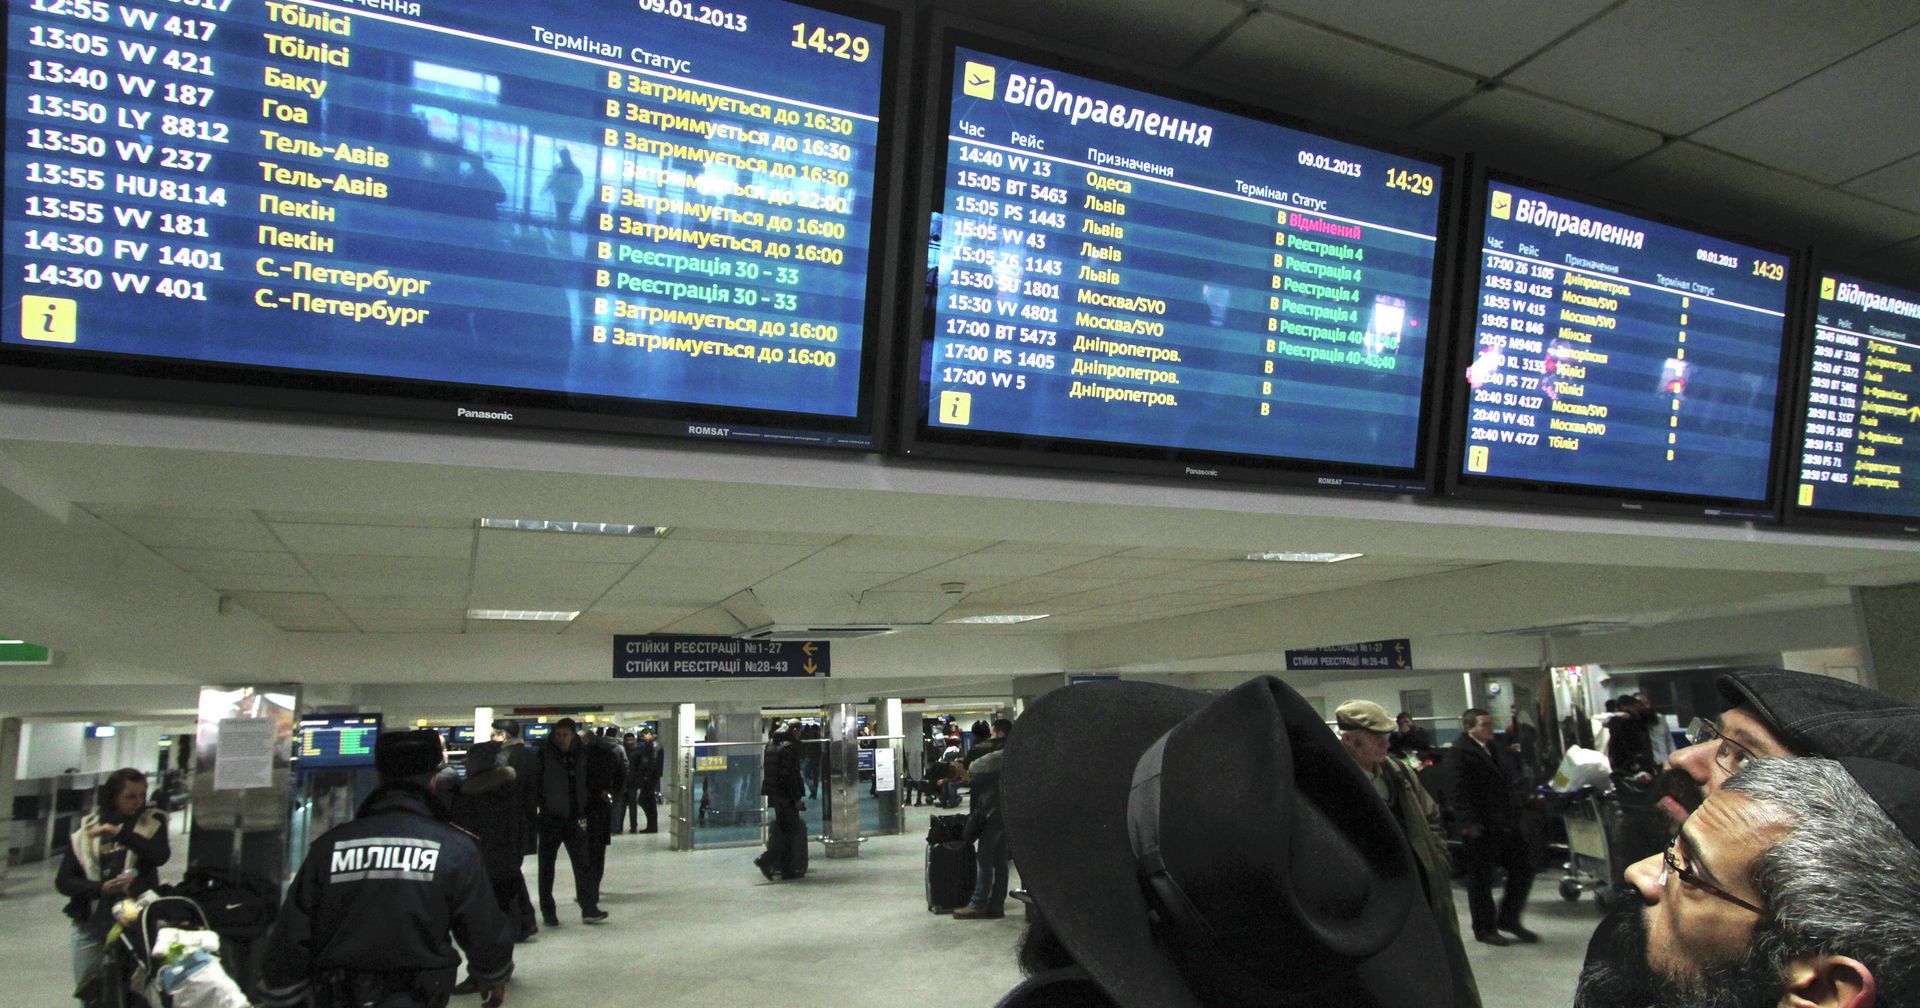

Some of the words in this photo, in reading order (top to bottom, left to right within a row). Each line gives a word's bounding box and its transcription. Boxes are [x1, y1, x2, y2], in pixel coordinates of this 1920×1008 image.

[119, 6, 159, 31] VV
[164, 16, 217, 41] 417
[265, 1, 351, 36] Тбілісі
[639, 0, 747, 32] 09.01.2013
[30, 26, 109, 56] 13:05
[118, 40, 157, 64] VV
[163, 50, 214, 76] 421
[264, 33, 349, 67] Тбілісі
[532, 26, 622, 60] Термінал
[631, 48, 691, 74] Статус
[791, 22, 869, 62] 14:29
[29, 60, 108, 90] 13:40
[117, 74, 156, 97] VV
[164, 83, 214, 107] 187
[264, 67, 328, 104] Баку
[263, 98, 308, 124] Гоа
[625, 72, 772, 123] Затримується
[773, 105, 801, 128] до
[803, 108, 853, 136] 16:30
[1004, 74, 1212, 147] Відправлення
[28, 94, 107, 124] 13:50
[118, 107, 152, 130] LY
[161, 115, 229, 143] 8812
[623, 101, 770, 150] Затримується
[771, 133, 799, 155] до
[801, 134, 851, 162] 16:30
[27, 128, 106, 157] 13:50
[115, 140, 154, 163] VV
[160, 147, 212, 172] 237
[260, 130, 389, 168] Тель-Авів
[622, 129, 768, 177] Затримується
[769, 160, 797, 182] до
[799, 161, 849, 188] 16:30
[960, 146, 1003, 167] 14:40
[1008, 155, 1029, 172] VV
[1032, 161, 1051, 177] 13
[26, 162, 105, 190] 13:55
[959, 120, 985, 137] Час
[1011, 131, 1044, 150] Рейс
[1088, 148, 1174, 177] Призначення
[1235, 180, 1288, 202] Термінал
[1292, 192, 1327, 212] Статус
[1298, 151, 1361, 177] 09.01.2013
[259, 162, 388, 198] Тель-Авів
[958, 170, 1000, 192] 15:05
[1006, 179, 1027, 196] BT
[1031, 184, 1067, 204] 5463
[1086, 171, 1132, 194] Одеса
[1386, 168, 1433, 196] 14:29
[26, 196, 104, 223] 13:55
[114, 206, 152, 229] VV
[160, 213, 209, 237] 181
[260, 194, 335, 222] Пекін
[618, 186, 765, 231] Затримується
[765, 213, 793, 235] до
[795, 214, 846, 241] 16:00
[955, 194, 999, 218] 15:05
[1004, 204, 1023, 221] PS
[1029, 209, 1066, 229] 1443
[1084, 195, 1125, 215] Львів
[953, 219, 997, 242] 15:05
[1000, 227, 1024, 247] VV
[1026, 233, 1046, 249] 43
[1082, 219, 1123, 239] Львів
[1290, 213, 1361, 239] Відмінений
[1515, 199, 1644, 249] Відправлення
[25, 230, 104, 256] 14:30
[114, 240, 149, 261] FV
[159, 246, 224, 271] 1401
[259, 225, 334, 253] Пекін
[619, 216, 762, 253] Затримується
[764, 242, 790, 259] до
[795, 244, 843, 265] 16:00
[1080, 242, 1122, 262] Львів
[1288, 234, 1354, 260] Реєстрація
[1488, 236, 1504, 249] Час
[1519, 243, 1539, 257] Рейс
[619, 245, 732, 277] Реєстрація
[735, 261, 759, 279] 30
[776, 267, 799, 285] 33
[1025, 257, 1062, 276] 1143
[1286, 256, 1352, 281] Реєстрація
[1487, 256, 1514, 272] 17:00
[1531, 265, 1554, 280] 1105
[1697, 249, 1738, 268] 09.01.2013
[1752, 260, 1784, 281] 14:29
[24, 263, 103, 289] 14:30
[112, 272, 150, 294] VV
[156, 278, 207, 301] 401
[256, 257, 431, 297] С.-Петербург
[949, 268, 994, 290] 15:30
[1023, 280, 1059, 299] 1801
[1078, 265, 1120, 285] Львів
[617, 272, 730, 303] Реєстрація
[733, 288, 757, 306] 30
[774, 293, 797, 311] 33
[1077, 288, 1166, 314] Москва/SVO
[1284, 277, 1350, 302] Реєстрація
[1528, 284, 1552, 298] 4125
[255, 289, 429, 327] С.-Петербург
[612, 299, 757, 338] Затримується
[758, 320, 786, 340] до
[788, 320, 838, 344] 16:00
[949, 293, 992, 313] 15:30
[997, 299, 1018, 317] VV
[1021, 304, 1058, 323] 4801
[1527, 303, 1545, 316] 415
[947, 318, 990, 337] 17:00
[995, 324, 1016, 340] BT
[1020, 328, 1056, 346] 5473
[1075, 312, 1164, 337] Москва/SVO
[612, 328, 755, 359] Затримується
[757, 347, 783, 364] до
[788, 348, 836, 367] 16:00
[945, 343, 988, 361] 17:00
[994, 348, 1012, 364] PS
[1018, 352, 1055, 369] 1405
[1073, 335, 1181, 362] Дніпропетров.
[1278, 341, 1345, 363] Реєстрація
[943, 367, 986, 385] 17:00
[991, 372, 1013, 388] VV
[1016, 375, 1025, 390] 5
[1071, 358, 1179, 385] Дніпропетров.
[1521, 377, 1539, 390] 727
[1069, 381, 1177, 407] Дніпропетров.
[1474, 386, 1502, 404] 20:40
[457, 407, 513, 421] Panasonic
[1473, 408, 1500, 423] 20:40
[1516, 414, 1535, 427] 451
[688, 426, 729, 436] ROMSAT
[626, 640, 669, 654] СТІЙКИ
[674, 641, 740, 655] РЕЄСТРАЦІЇ
[745, 643, 782, 654] №1-27
[626, 658, 669, 673] СТІЙКИ
[674, 660, 740, 674] РЕЄСТРАЦІЇ
[745, 661, 788, 673] №28-43
[330, 846, 439, 872] МІЛІЦІЯ
